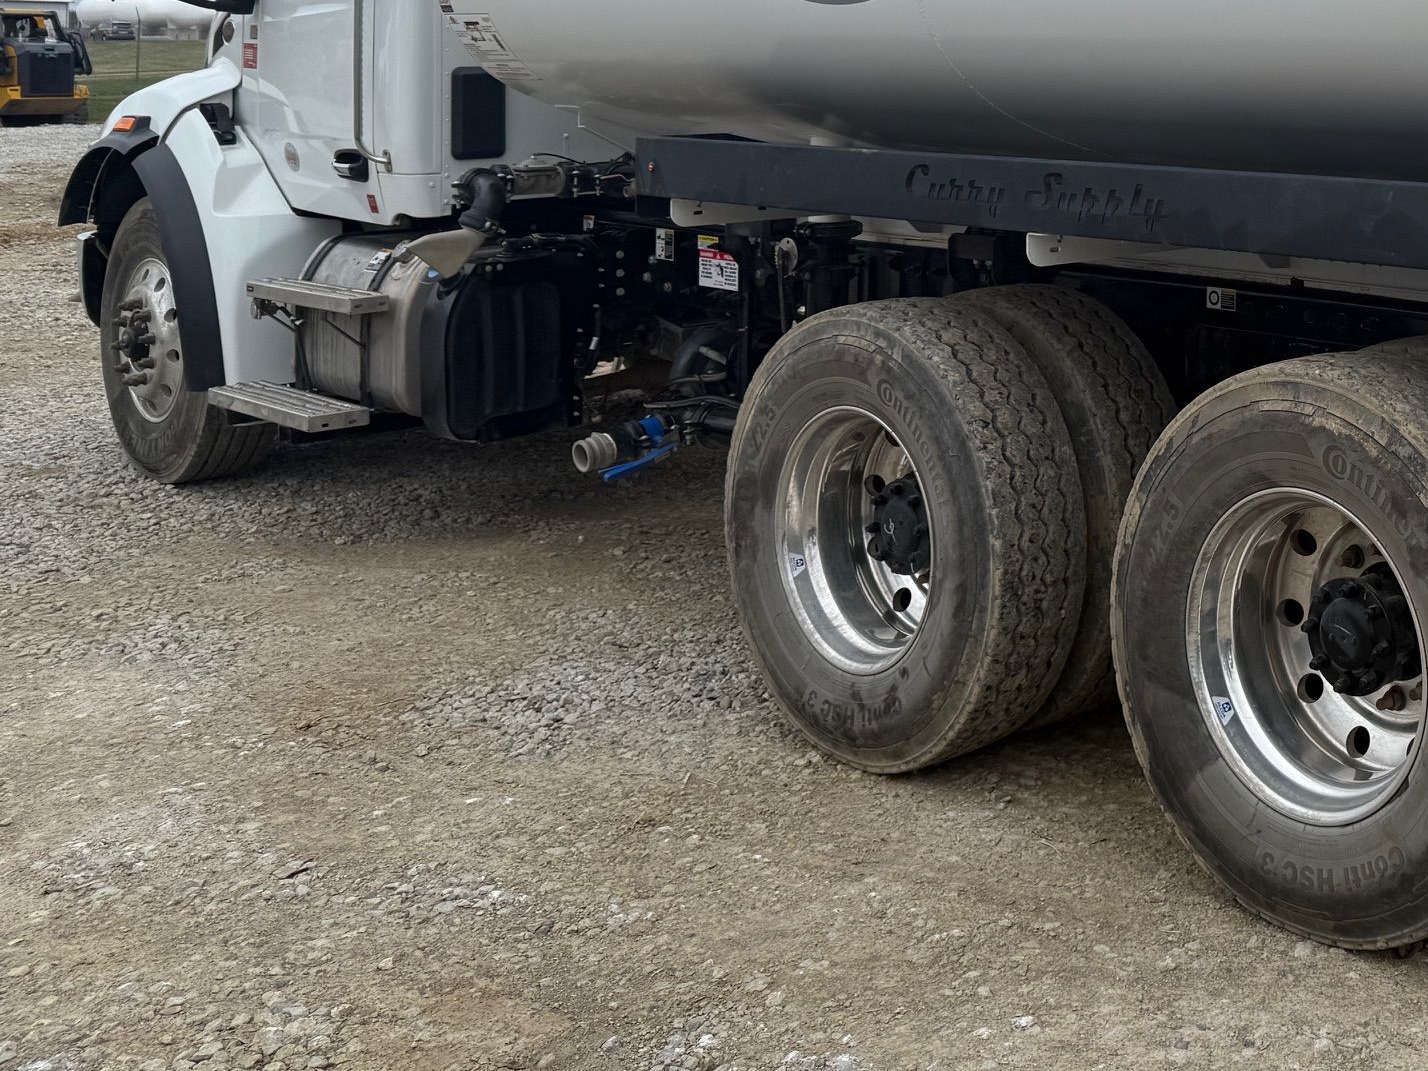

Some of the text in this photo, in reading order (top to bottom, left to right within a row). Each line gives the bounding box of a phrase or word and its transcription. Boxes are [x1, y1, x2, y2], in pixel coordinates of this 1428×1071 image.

[904, 163, 1169, 232] Curry Supply
[1281, 860, 1335, 894] HSC
